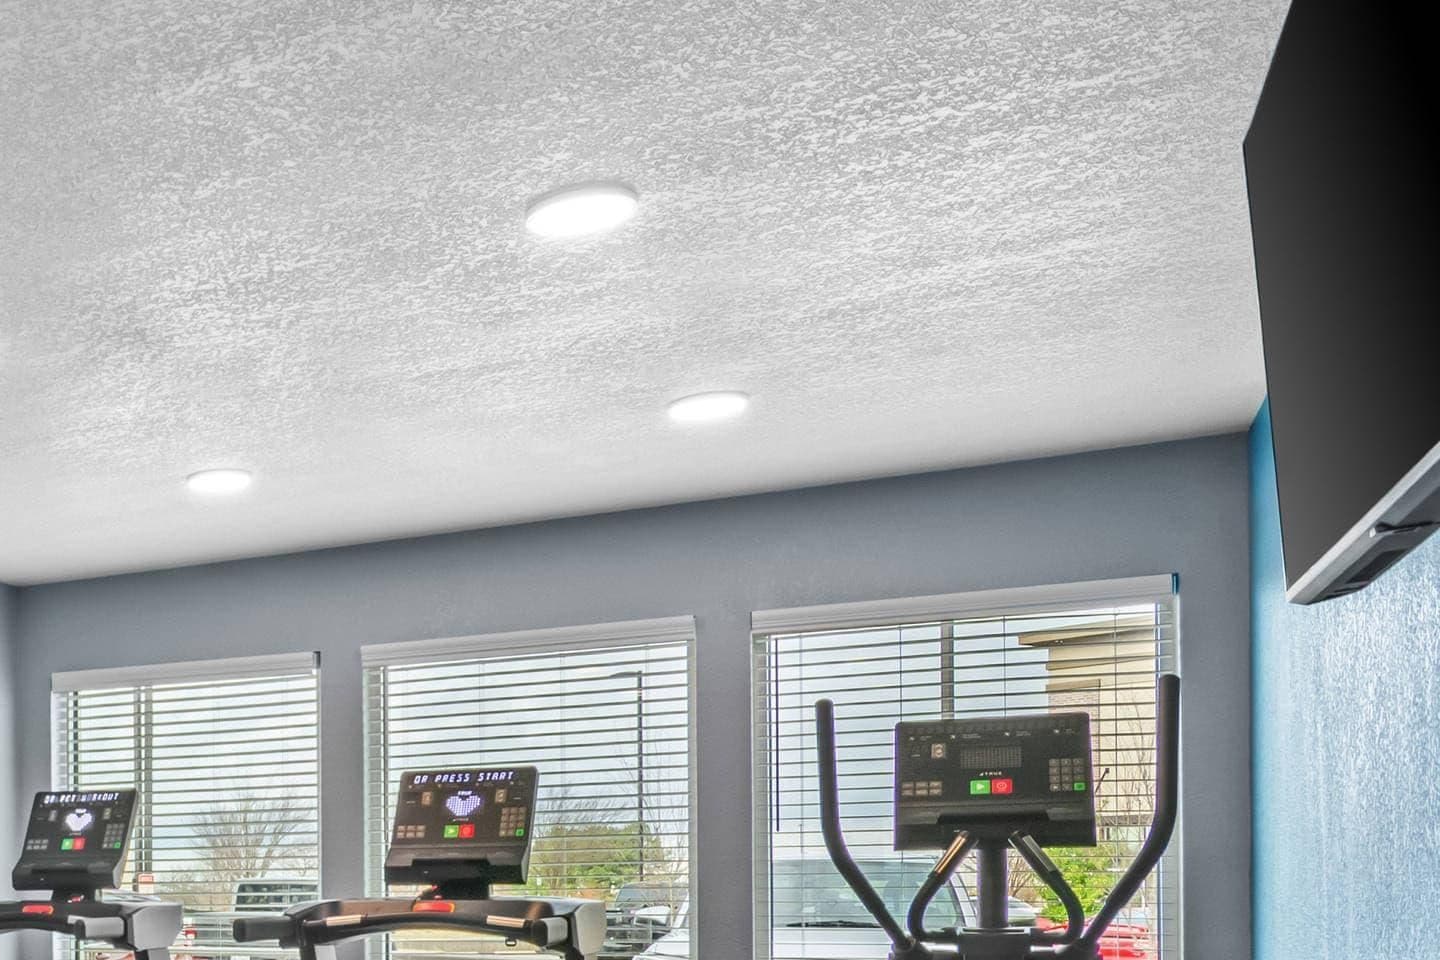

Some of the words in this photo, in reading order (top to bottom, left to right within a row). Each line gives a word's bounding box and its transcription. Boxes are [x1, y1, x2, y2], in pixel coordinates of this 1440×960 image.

[414, 775, 428, 784] OR
[435, 773, 470, 783] PRESS
[478, 771, 513, 782] START
